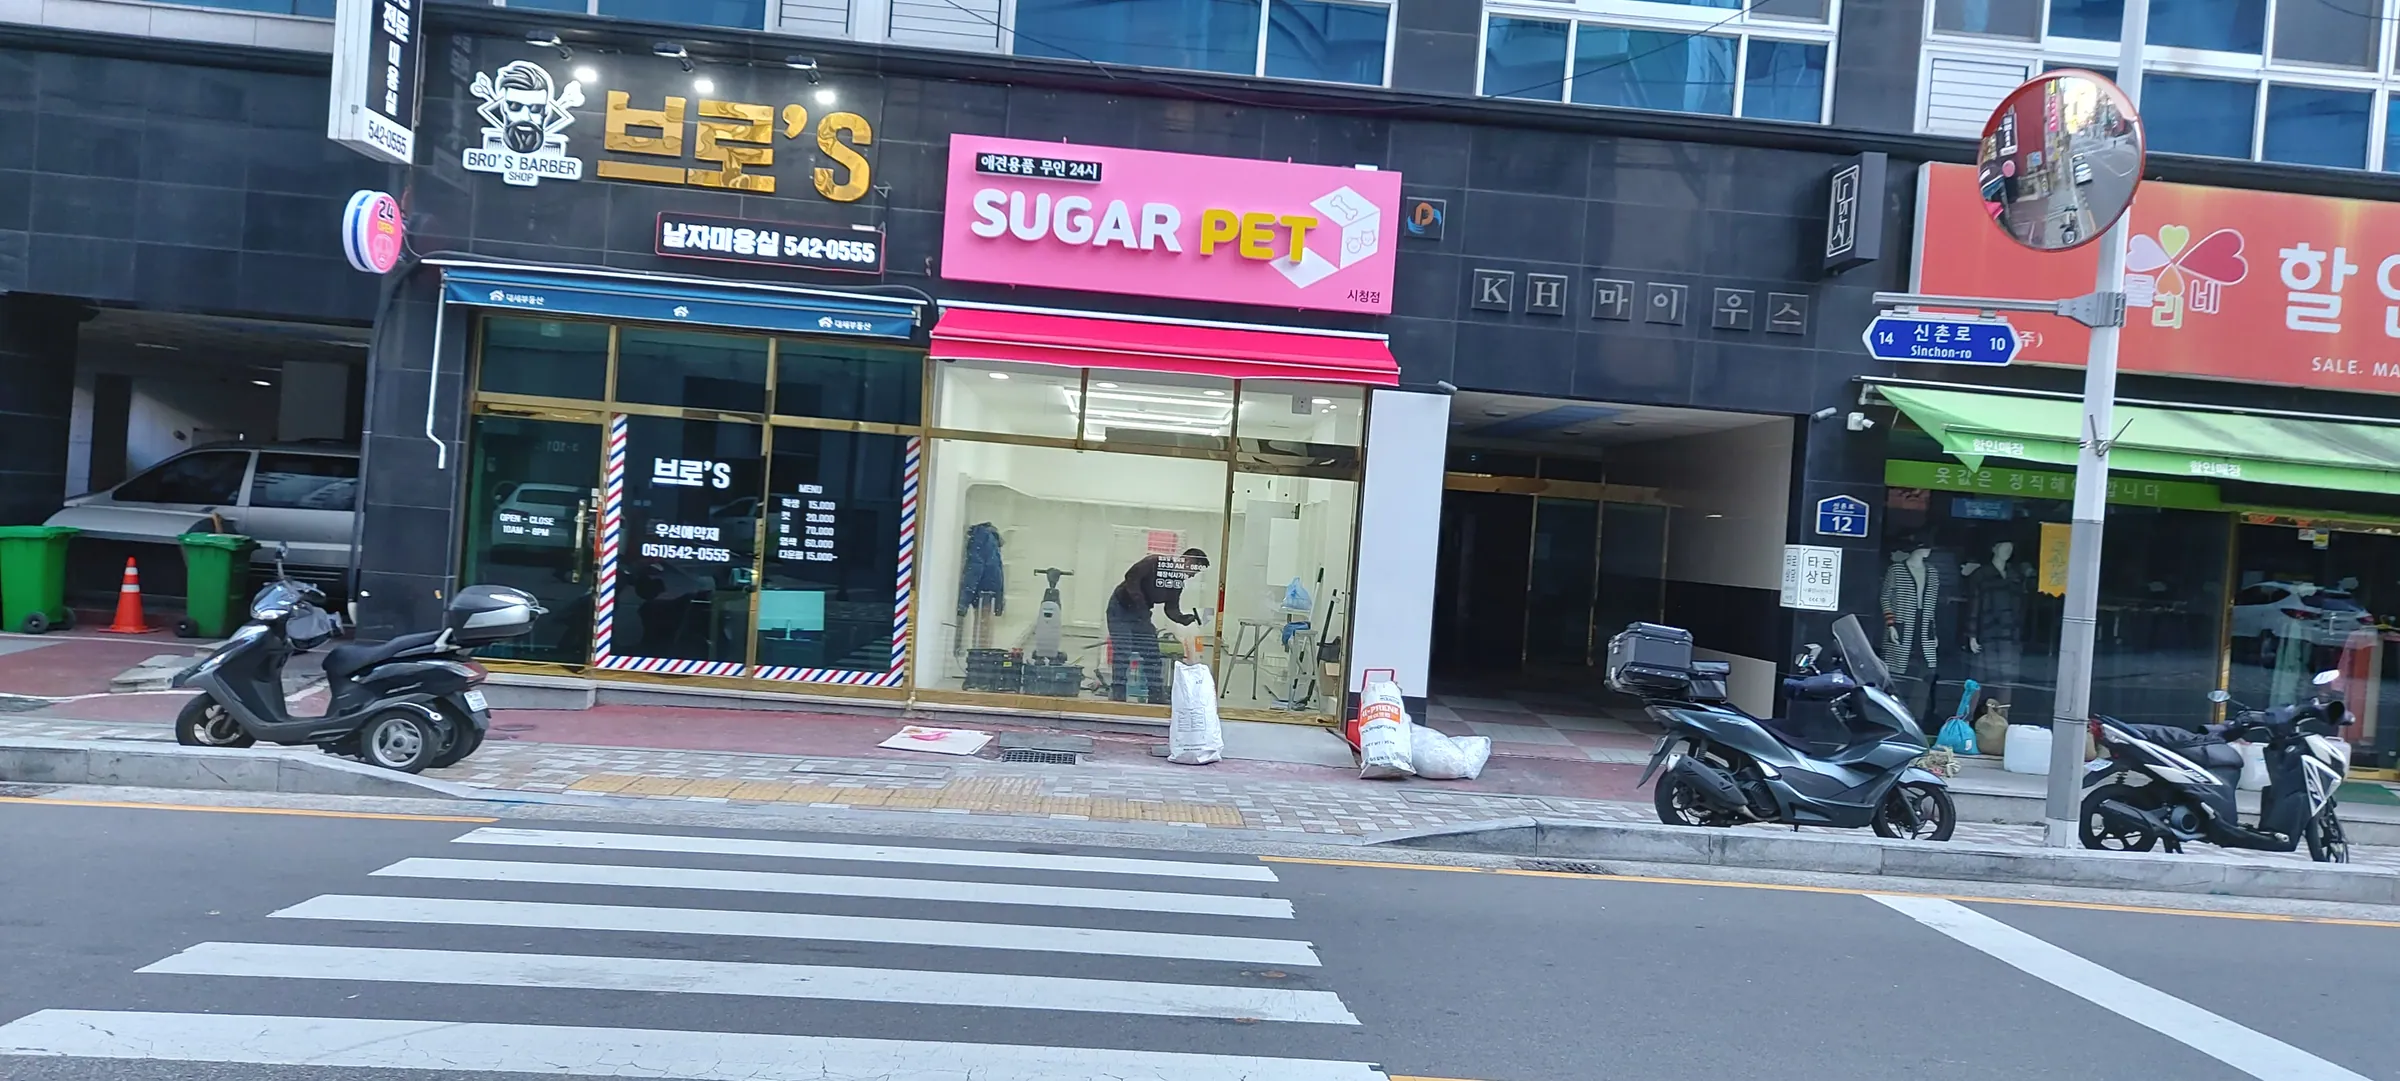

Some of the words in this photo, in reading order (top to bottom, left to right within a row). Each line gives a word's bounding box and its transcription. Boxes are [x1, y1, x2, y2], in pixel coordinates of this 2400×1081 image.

[385, 40, 401, 117] 미용실
[367, 119, 407, 156] 542-0555
[597, 89, 873, 202] 브로'S
[519, 156, 577, 176] BARBER
[980, 154, 1035, 174] 애견용품
[1040, 160, 1066, 177] 무인
[1069, 162, 1098, 179] 24시
[508, 171, 534, 182] SHOP
[379, 200, 395, 219] 24
[970, 187, 1183, 254] SUGAR
[1198, 208, 1319, 264] PET
[663, 222, 780, 258] 남자미용실
[783, 234, 876, 264] 542-0555
[1347, 289, 1381, 304] 시청점
[1878, 331, 1894, 345] 14
[1913, 324, 1972, 344] 신촌로
[1989, 337, 2006, 351] 10
[1910, 345, 1972, 359] Sinchon-ro
[1972, 438, 2025, 456] 할인매장
[651, 457, 731, 489] 브로'S
[2189, 460, 2242, 477] 할인매장
[798, 483, 823, 494] MENU
[1935, 467, 1993, 488] 옷값은
[2008, 473, 2077, 493] 정직해
[499, 513, 521, 523] OPEN
[528, 515, 555, 527] CLOSE
[1831, 515, 1853, 532] 12
[502, 525, 524, 535] 10AM
[655, 523, 720, 541] 우선예약제
[642, 543, 731, 562] 051)542-0555
[1807, 556, 1834, 570] 타로
[1805, 570, 1834, 585] 상담
